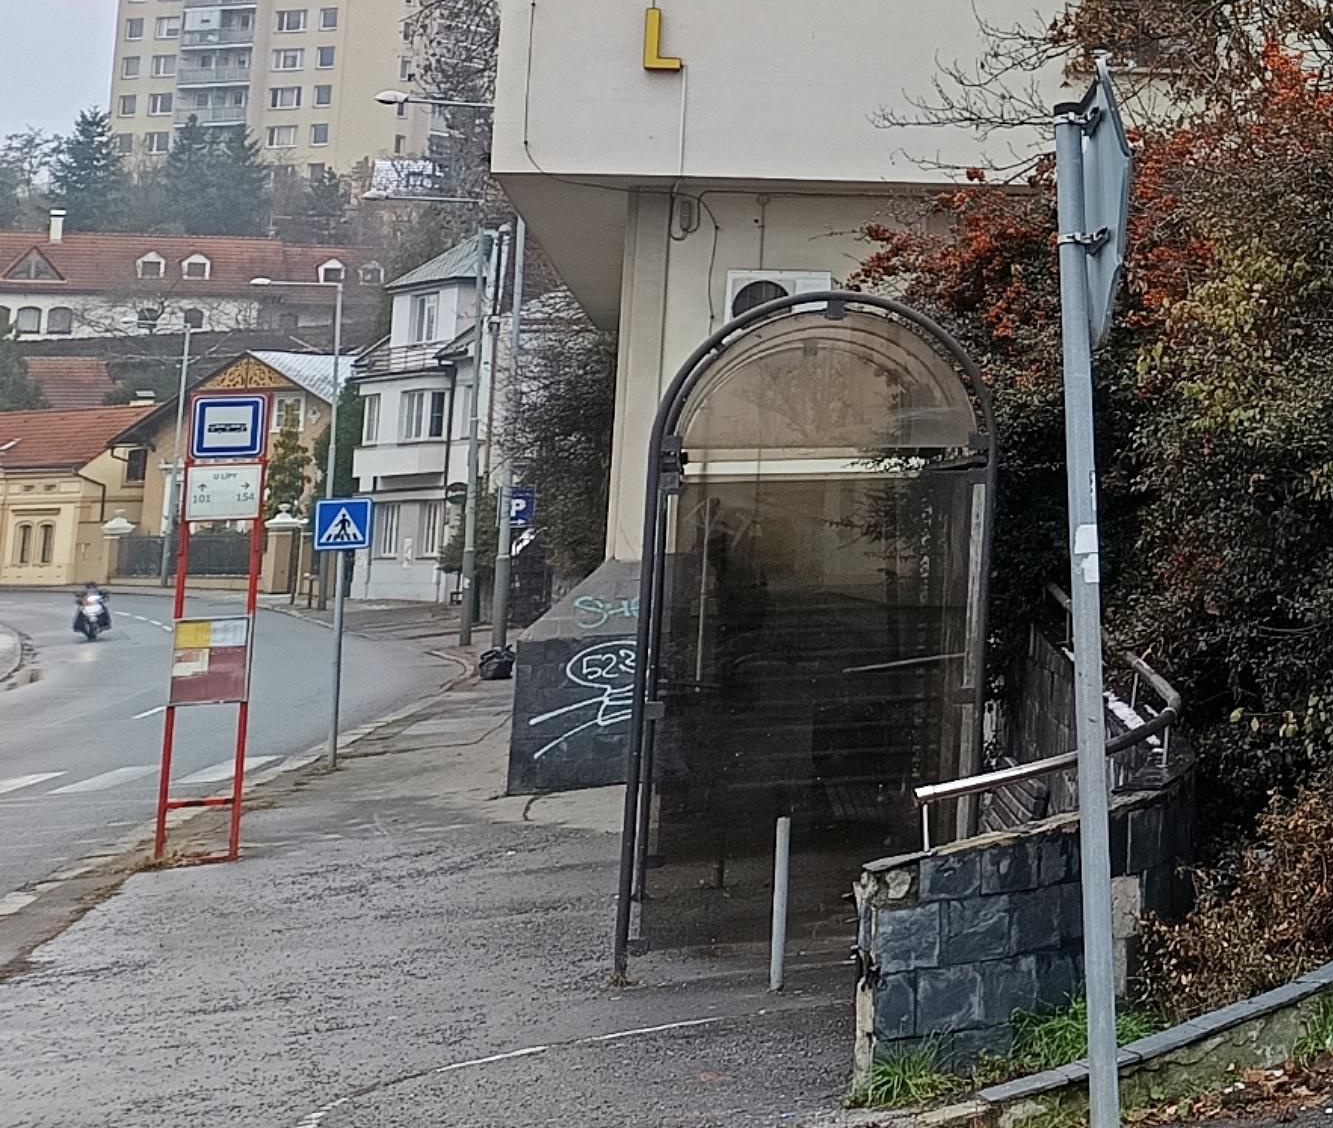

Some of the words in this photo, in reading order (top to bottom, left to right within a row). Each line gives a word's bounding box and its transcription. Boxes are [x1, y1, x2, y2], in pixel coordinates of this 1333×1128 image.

[193, 494, 211, 504] 101
[236, 492, 255, 502] 154
[510, 498, 527, 517] P
